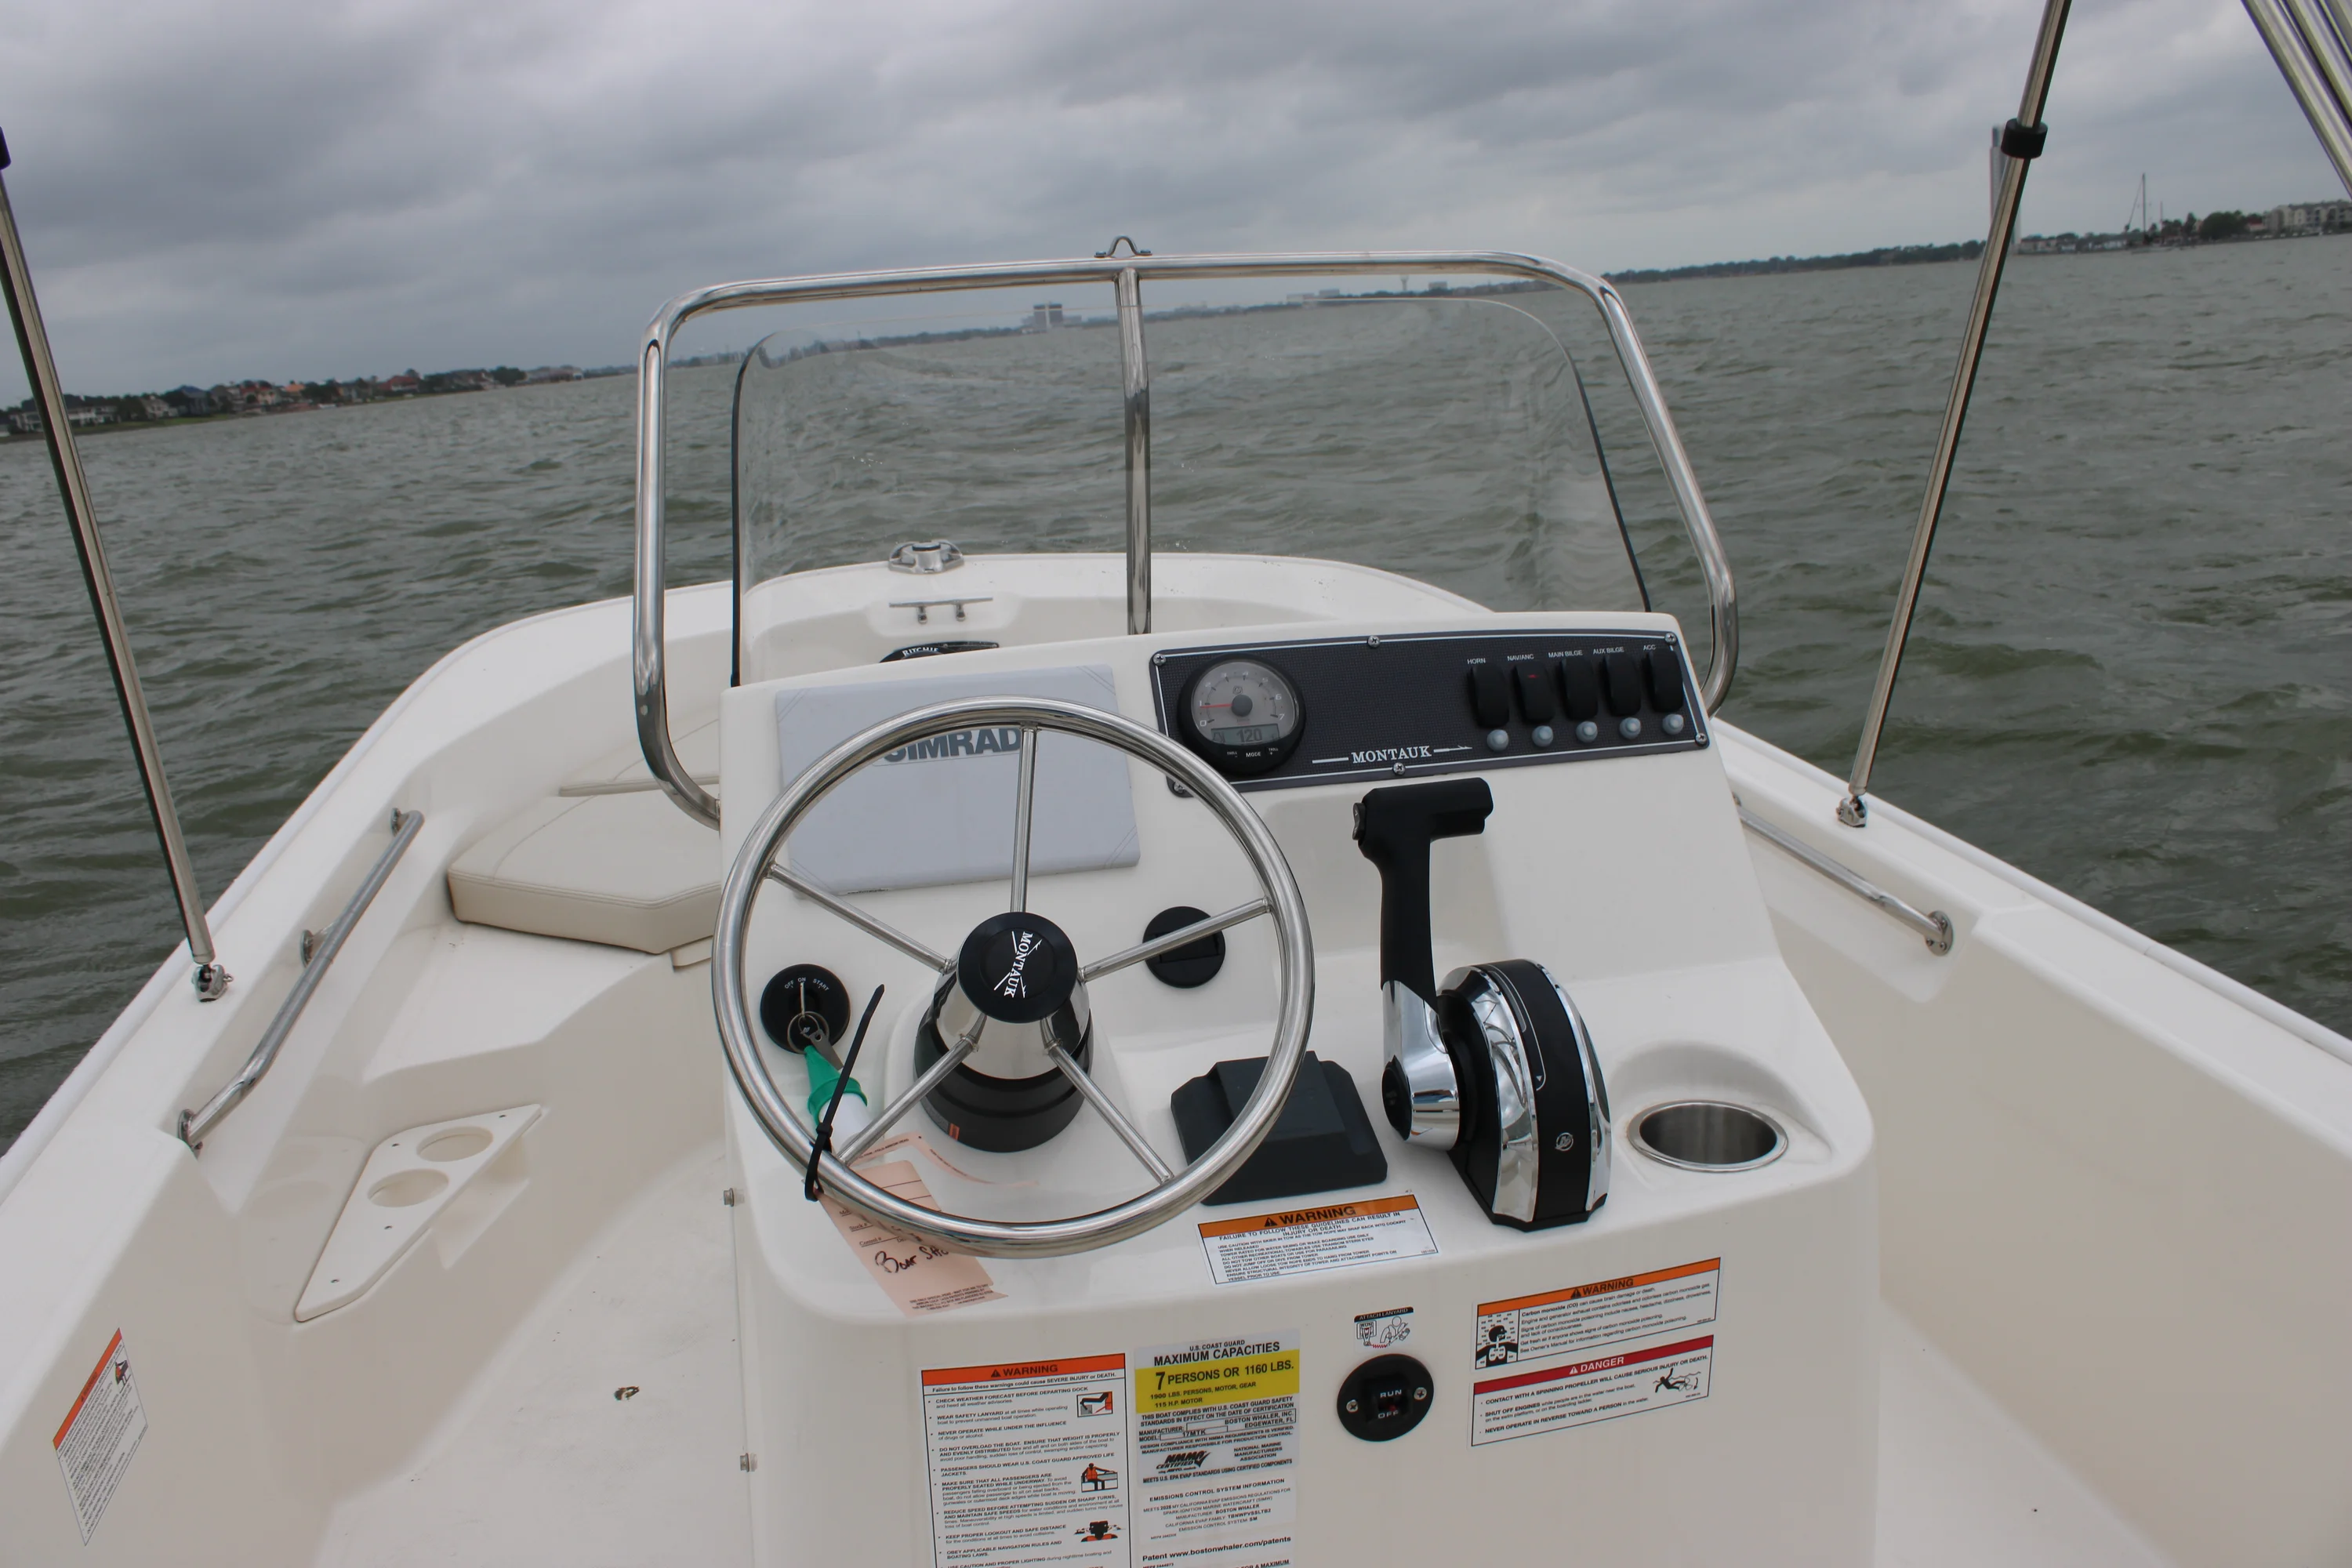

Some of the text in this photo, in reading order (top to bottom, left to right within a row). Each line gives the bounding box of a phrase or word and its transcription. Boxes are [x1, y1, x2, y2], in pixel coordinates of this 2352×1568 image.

[902, 647, 939, 656] RITCHIE
[1236, 728, 1263, 742] 120
[1351, 746, 1432, 764] MONTAUK
[1004, 931, 1033, 998] MONTAUK
[785, 980, 794, 989] OFF
[813, 978, 829, 991] START
[1279, 1205, 1356, 1225] WARNING
[1310, 1218, 1350, 1228] GUIDELINES
[1582, 1278, 1633, 1296] WARNING
[1522, 1308, 1540, 1317] Carbon
[1541, 1304, 1565, 1313] monoxide
[1153, 1341, 1279, 1367] MAXIMUM CAPACITIES
[1003, 1364, 1058, 1377] WARNING
[1580, 1356, 1624, 1373] DANGER
[1167, 1359, 1294, 1385] PERSONS OR 1160 LBS.
[1155, 1371, 1166, 1390] 7
[1486, 1395, 1512, 1406] CONTACT
[1514, 1391, 1530, 1399] WITH
[1536, 1384, 1563, 1396] SPINNING
[1564, 1377, 1598, 1389] PROPELLER
[1613, 1370, 1632, 1379] CAUSE
[1634, 1365, 1658, 1375] SERIOUS
[1659, 1361, 1679, 1370] INJURY
[1689, 1355, 1708, 1364] DEATH.
[1183, 1387, 1213, 1396] PERSONS,
[1380, 1389, 1402, 1398] RUN
[1172, 1407, 1201, 1416] COMPLIES
[1515, 1401, 1540, 1411] ENGINES
[1140, 1417, 1174, 1427] STANDARDS
[1252, 1402, 1294, 1413] CERTIFICATION
[1225, 1416, 1250, 1425] BOSTON
[1252, 1412, 1279, 1421] WHALER,
[1377, 1410, 1399, 1419] OFF
[1485, 1425, 1504, 1435] NEVER
[1505, 1420, 1532, 1430] OPERATE
[1541, 1412, 1566, 1423] REVERSE
[1568, 1407, 1592, 1417] TOWARD
[1599, 1401, 1621, 1411] PERSON
[1244, 1417, 1284, 1428] EDGEWATER,
[1138, 1425, 1184, 1436] MANUFACTURER:
[1182, 1428, 1205, 1437] 17MTK
[1234, 1446, 1282, 1457] MANUFACTURERS
[1156, 1460, 1193, 1469] CERTIFIED
[1192, 1468, 1220, 1477] STANDARDS
[1236, 1462, 1260, 1472] CERTIFIED
[1261, 1458, 1292, 1468] COMPONENTS
[1149, 1478, 1284, 1501] EMISSIONS CONTROL SYSTEM INFORMATION
[1142, 1552, 1167, 1562] Patent
[1169, 1535, 1290, 1559] www.bostonwhaler.com/patents
